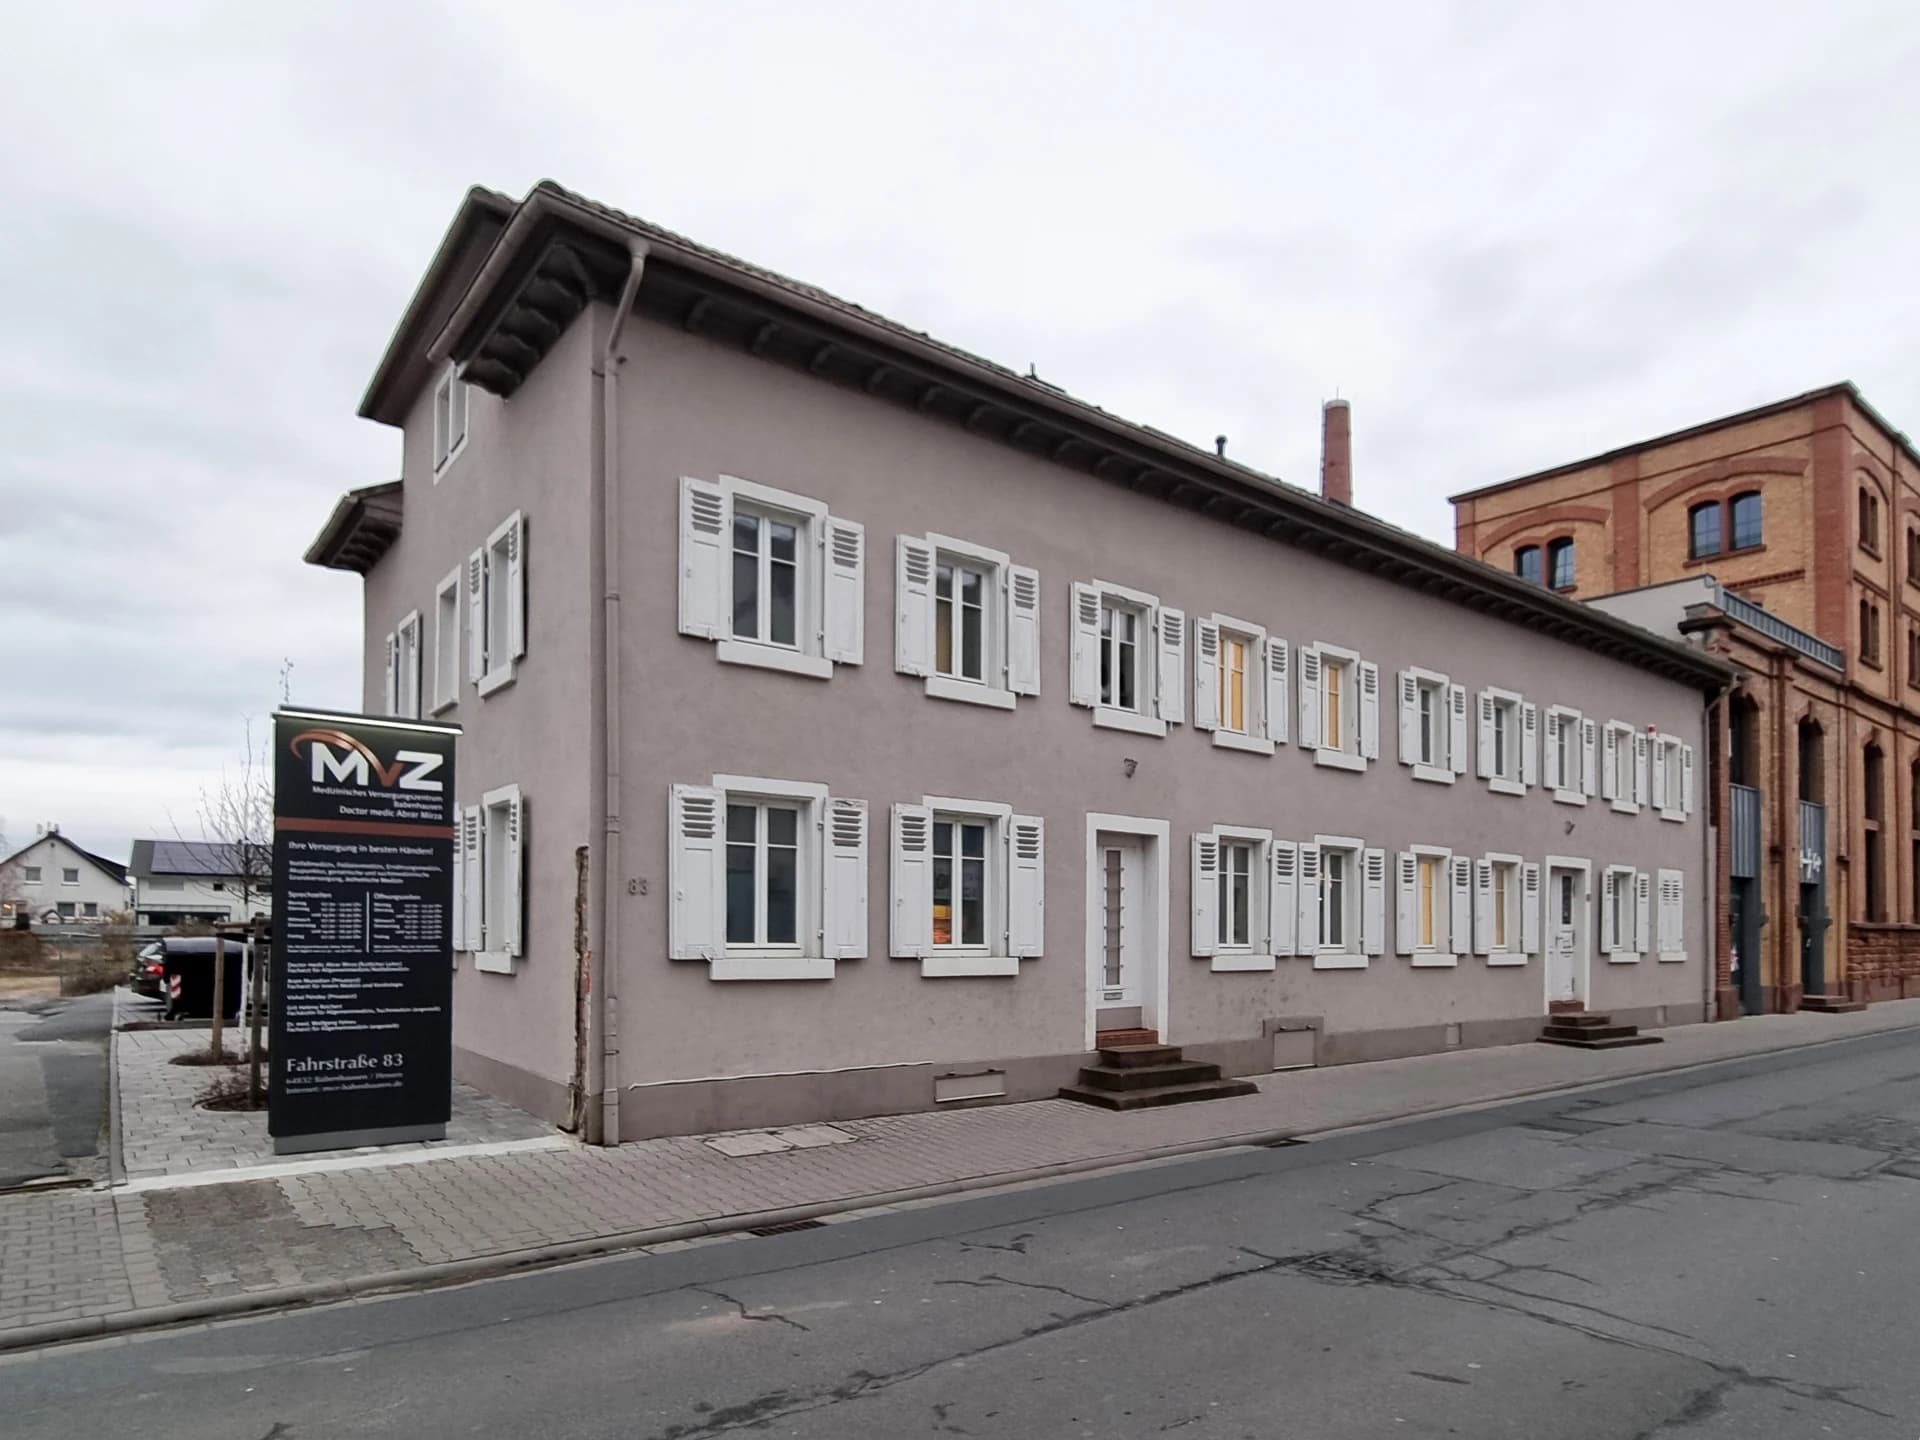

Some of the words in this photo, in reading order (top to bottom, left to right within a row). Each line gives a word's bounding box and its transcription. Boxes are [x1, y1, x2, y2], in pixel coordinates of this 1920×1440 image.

[339, 805, 368, 816] Doctor
[370, 807, 394, 818] medic
[288, 841, 306, 850] Ihre
[307, 841, 358, 854] Versorgung
[358, 844, 368, 853] in
[368, 844, 398, 854] besten
[287, 1053, 378, 1072] Fahrstraße
[383, 1053, 403, 1067] 83
